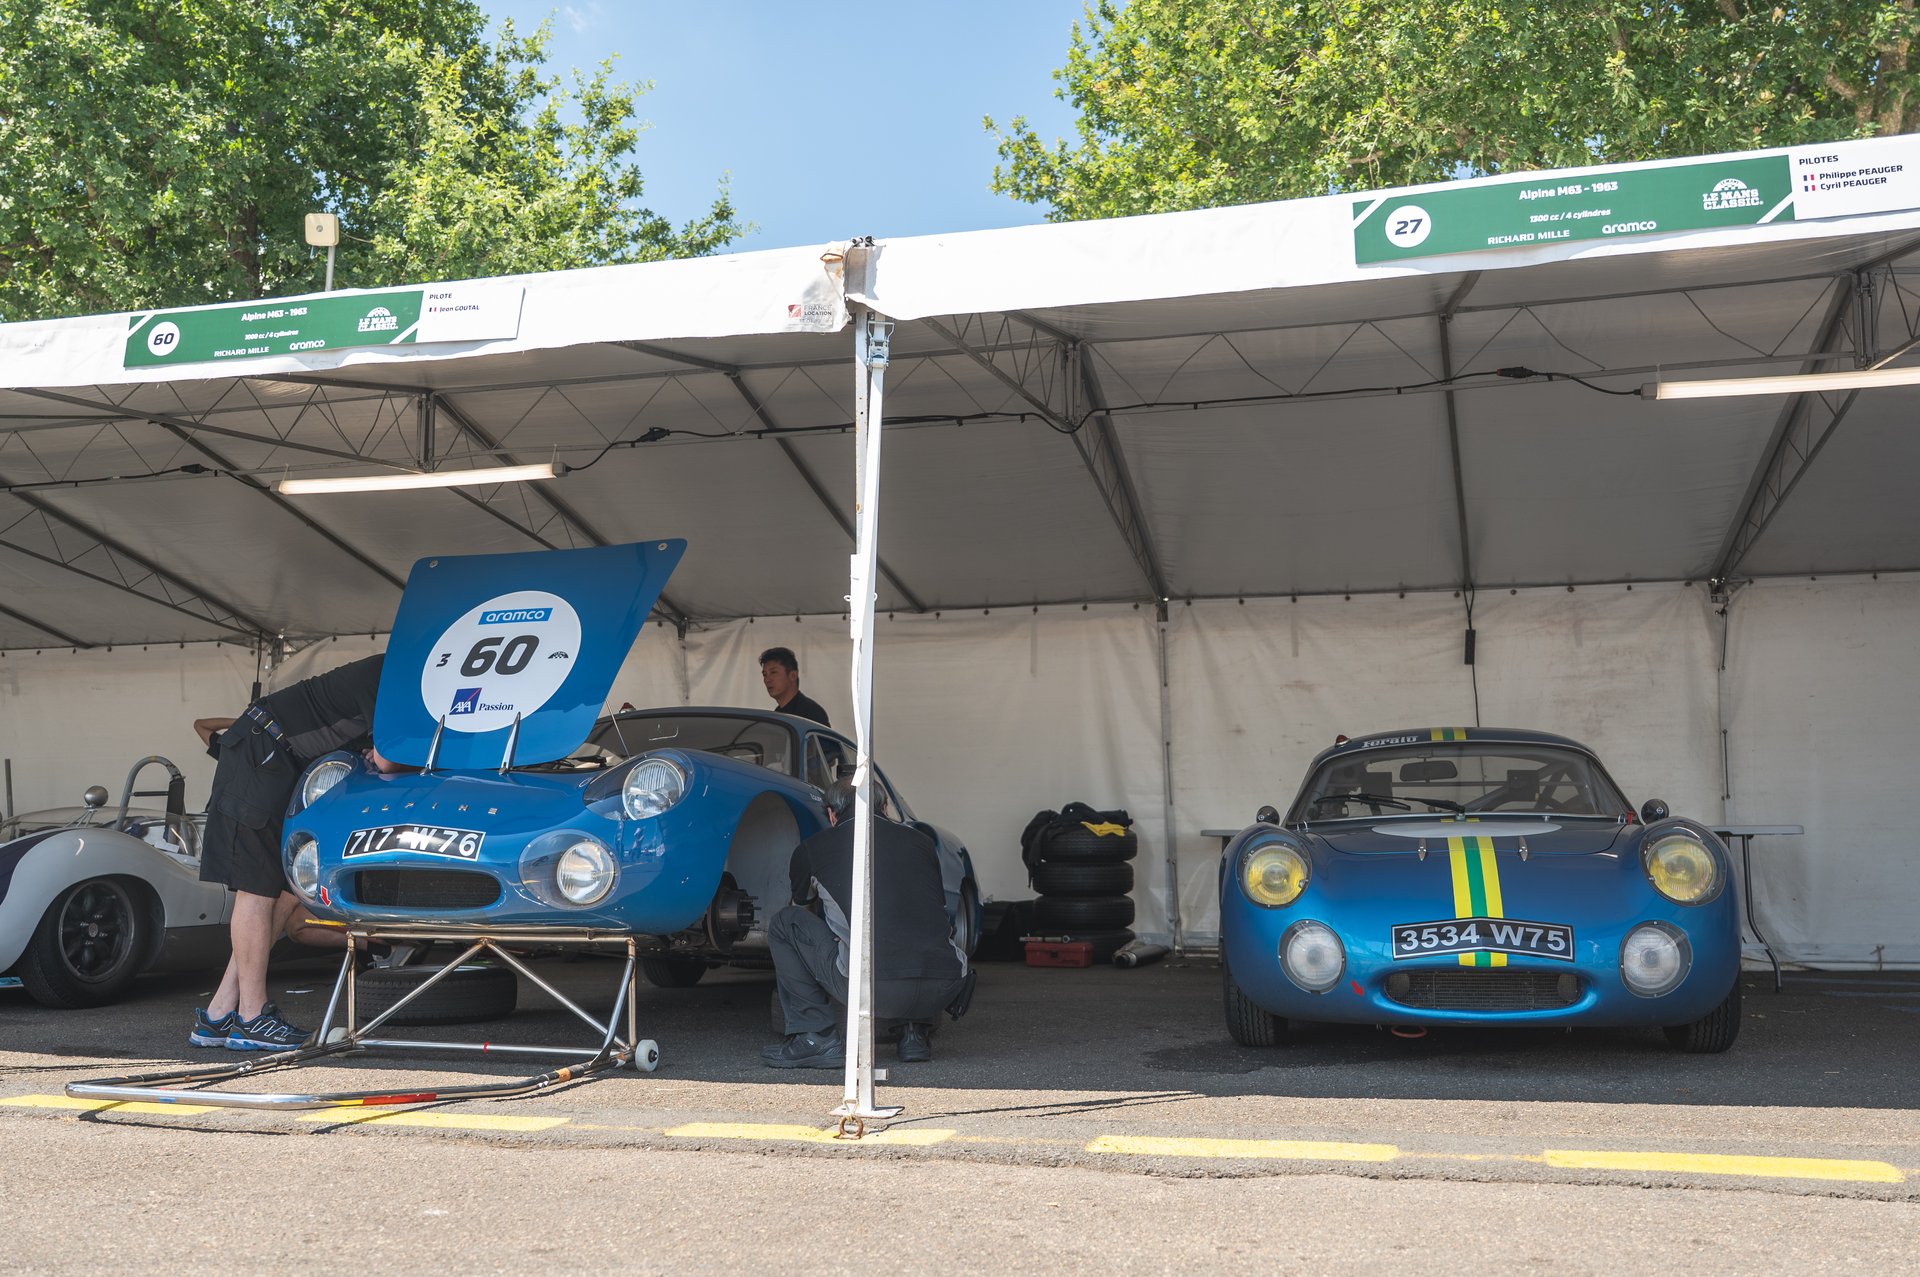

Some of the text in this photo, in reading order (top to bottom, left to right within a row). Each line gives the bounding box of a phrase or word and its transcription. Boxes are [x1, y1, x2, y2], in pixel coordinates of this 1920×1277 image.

[1799, 154, 1839, 165] PILOTES
[1819, 164, 1903, 180] Philippe PEAUGER
[1820, 176, 1887, 191] Cyril PEAUGER
[1519, 187, 1555, 201] Alpine
[1557, 184, 1583, 196] M63
[1591, 181, 1618, 193] 1963
[1702, 188, 1759, 202] LE MANS
[1530, 214, 1549, 223] 1300
[1549, 213, 1560, 221] cc
[1566, 211, 1572, 220] 4
[1572, 208, 1612, 220] cylindres
[1394, 218, 1423, 235] 27
[1601, 220, 1657, 234] aramco
[1487, 229, 1571, 245] RICHARD MILLE
[241, 312, 266, 321] Alpine
[153, 333, 175, 346] 60
[289, 340, 325, 350] aramco
[214, 346, 270, 357] RICHARD MILLE
[486, 610, 545, 622] aramco
[436, 653, 452, 667] 3
[460, 634, 540, 677] 60
[450, 701, 514, 713] AXA Passion
[349, 827, 394, 854] 717
[1401, 923, 1566, 951] 3534 W75
